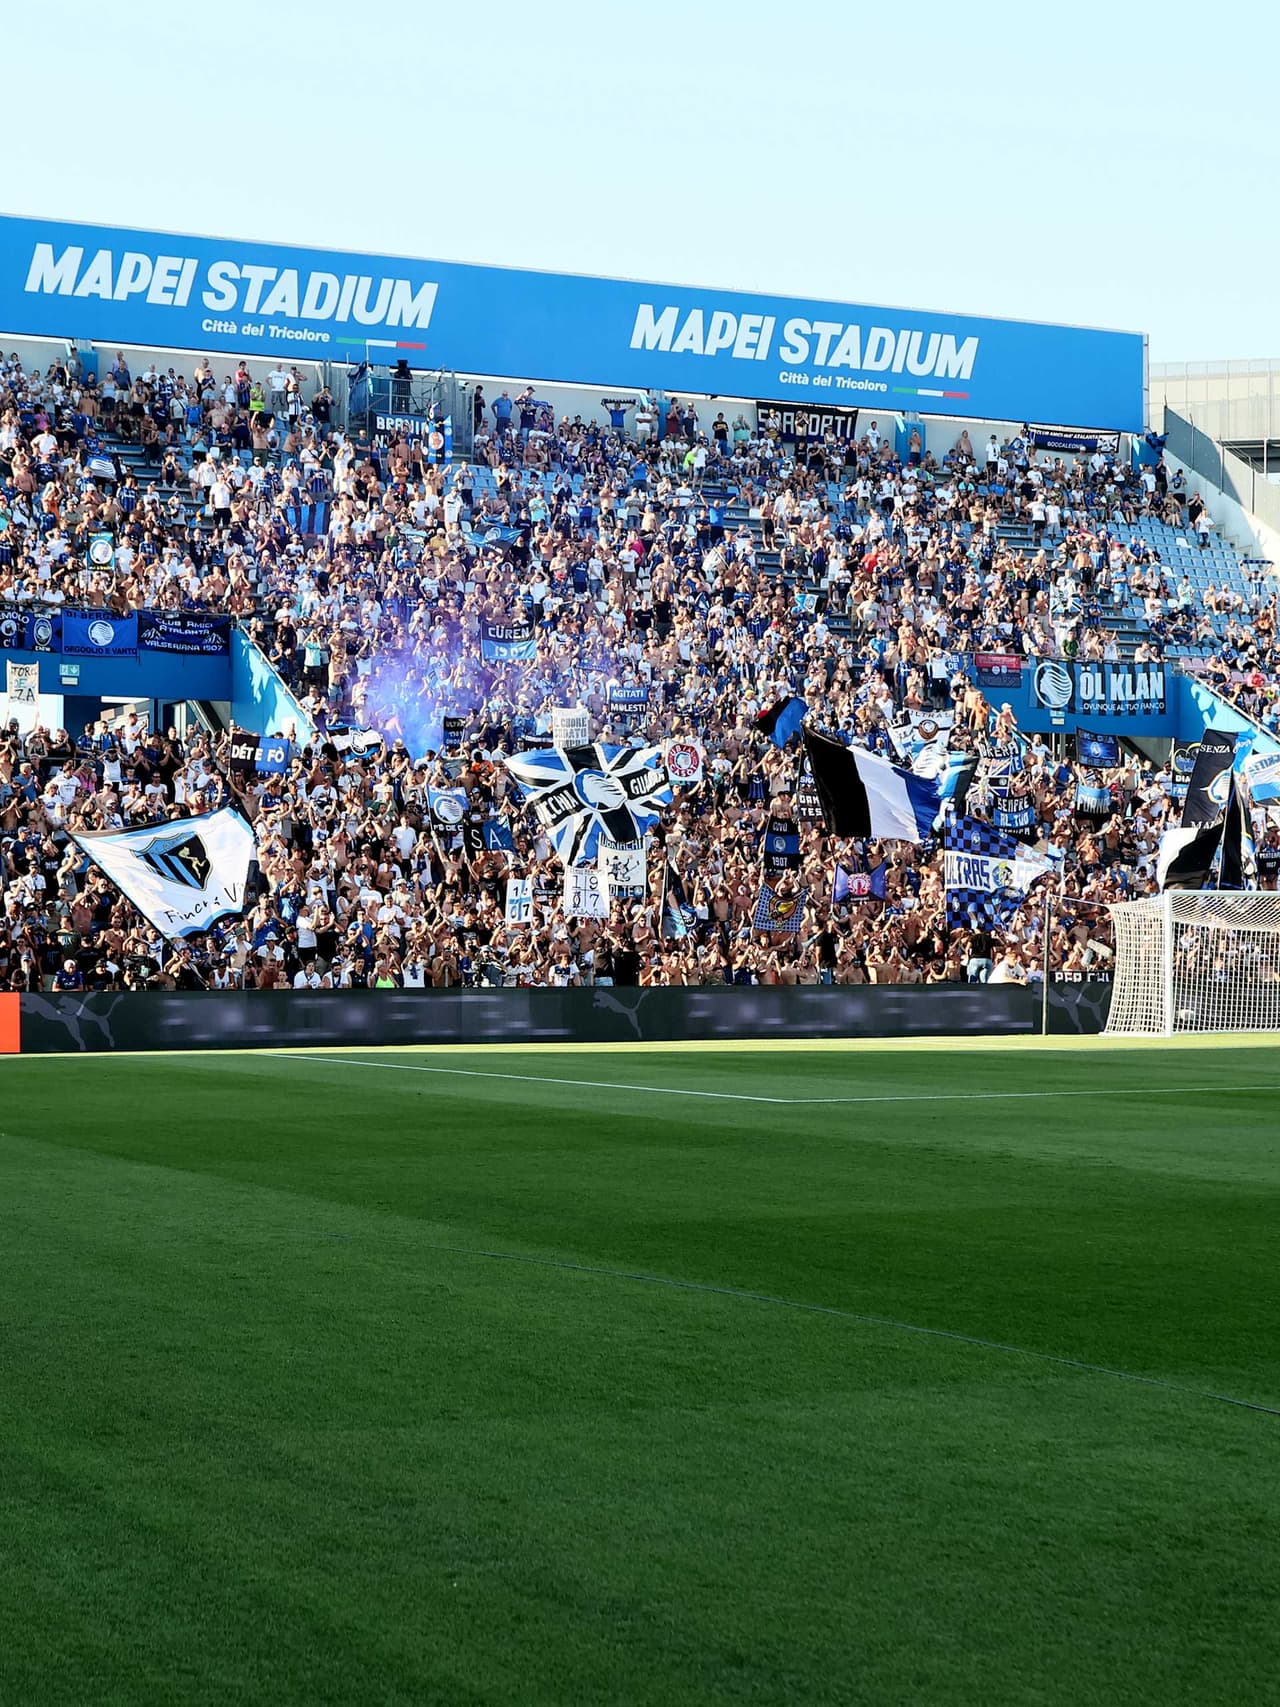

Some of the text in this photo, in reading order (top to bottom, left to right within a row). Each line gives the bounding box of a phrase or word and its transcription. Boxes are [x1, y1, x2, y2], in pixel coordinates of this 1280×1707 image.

[24, 242, 439, 329] MAPEI STADIUM
[202, 318, 331, 343] Città del Tricolore
[630, 303, 980, 380] MAPEI STADIUM
[779, 371, 888, 392] Città del Tricolore
[155, 618, 213, 629] CLUB AMICI
[159, 624, 210, 635] ATALANTA
[144, 639, 200, 651] VALSERIANA
[612, 689, 645, 698] AGITATI
[1080, 666, 1164, 701] ÖL KLAN
[231, 743, 255, 760] DÉT
[267, 746, 285, 763] FÒ
[1200, 744, 1230, 754] SENZA
[946, 855, 991, 889] ULTRAS
